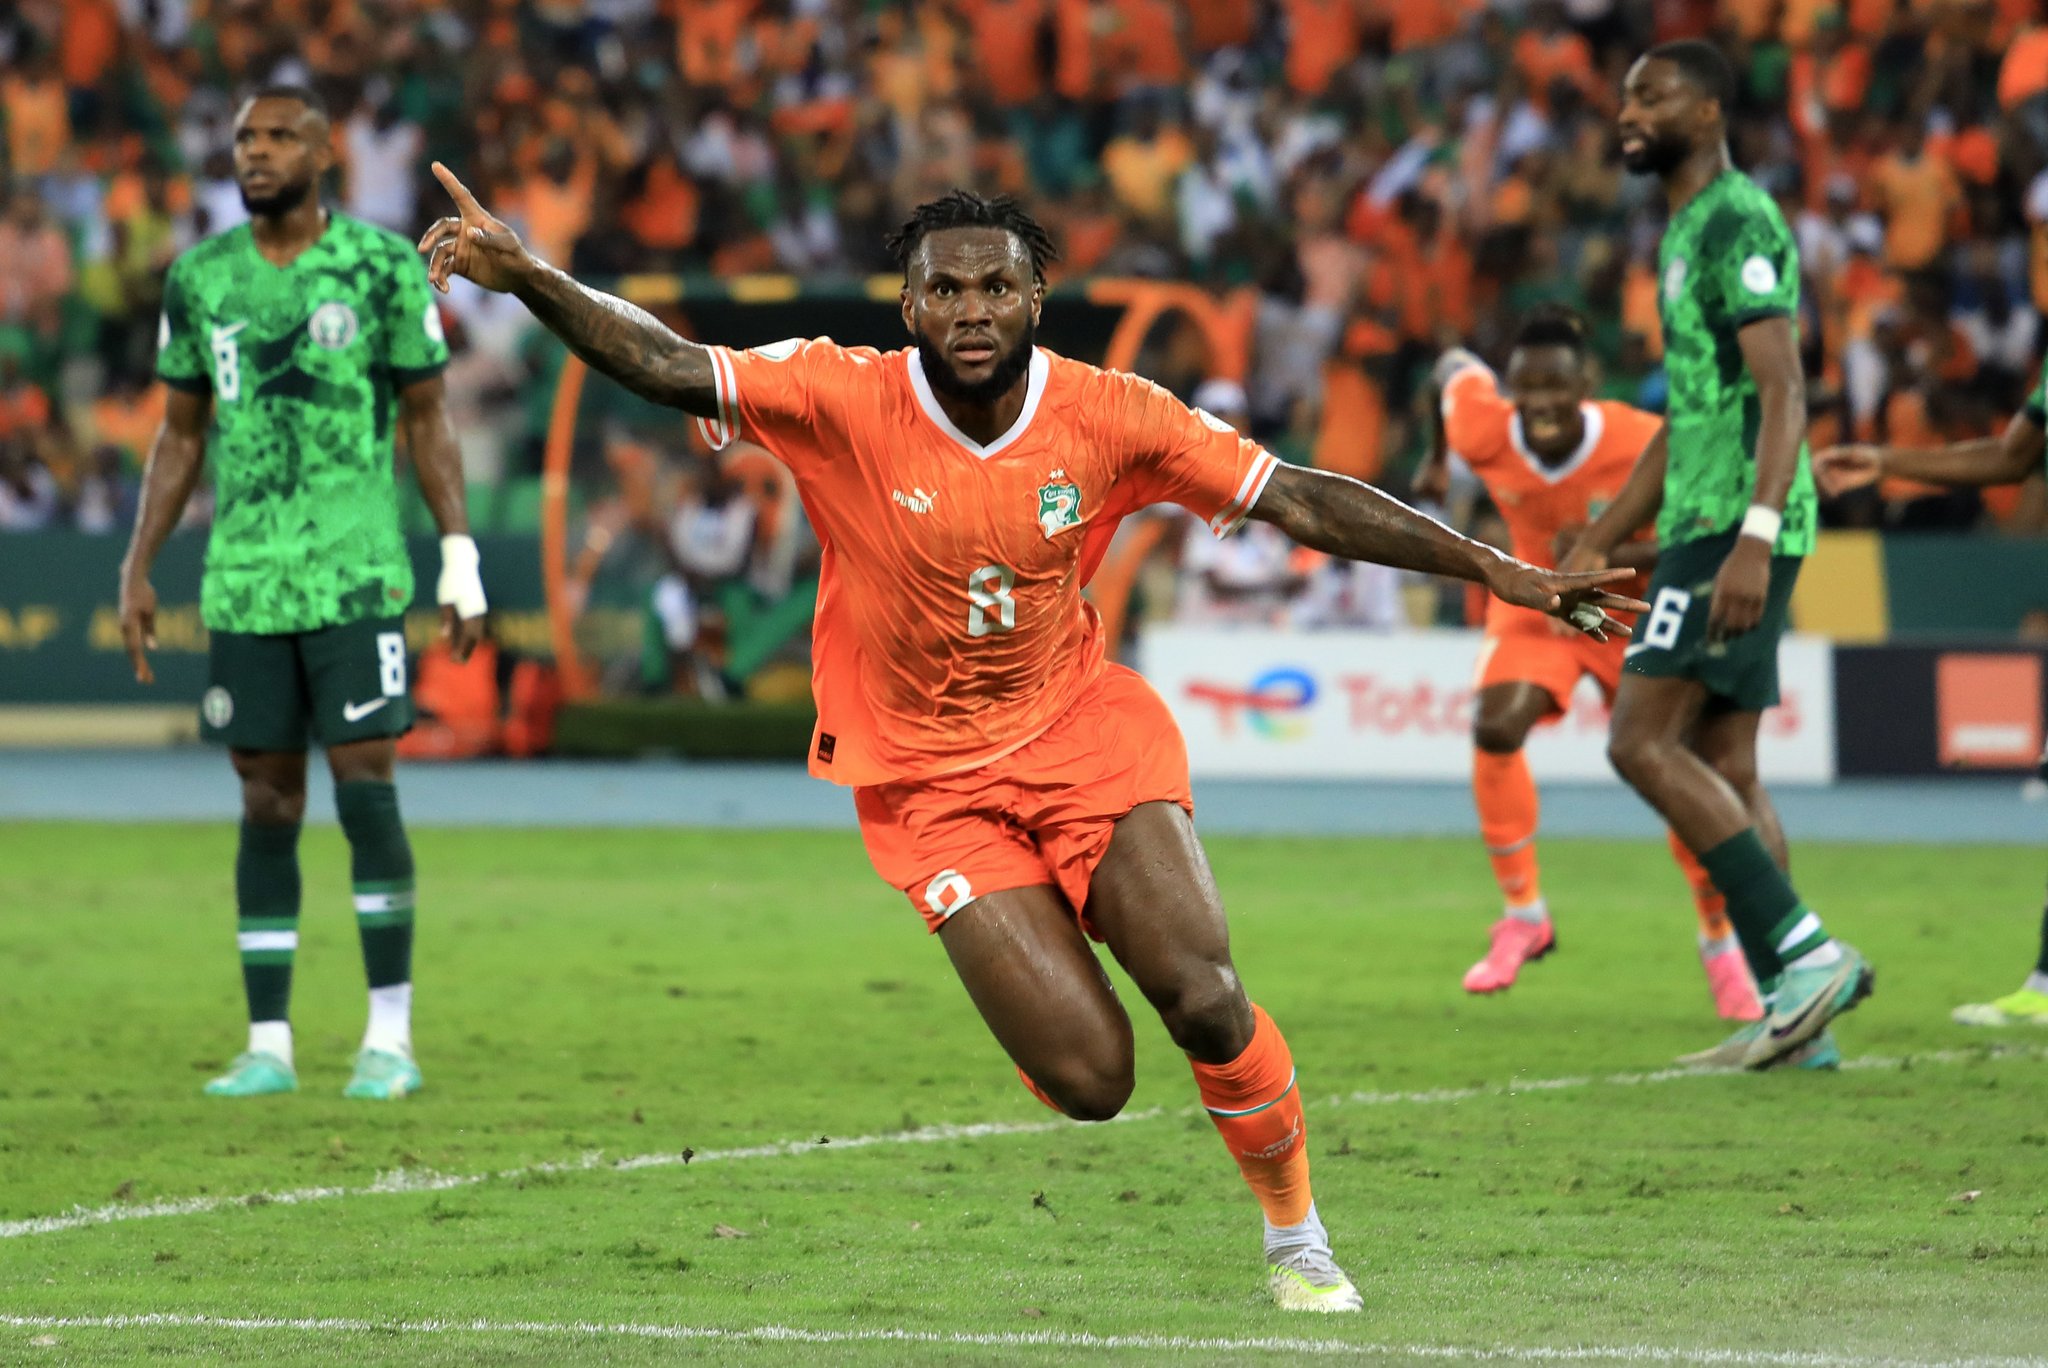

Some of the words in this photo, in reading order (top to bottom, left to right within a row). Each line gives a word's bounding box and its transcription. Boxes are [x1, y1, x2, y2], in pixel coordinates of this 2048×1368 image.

[211, 336, 240, 401] 8
[892, 488, 928, 514] PUMA
[968, 564, 1016, 637] 8
[1644, 586, 1691, 650] 6
[377, 632, 406, 696] 8
